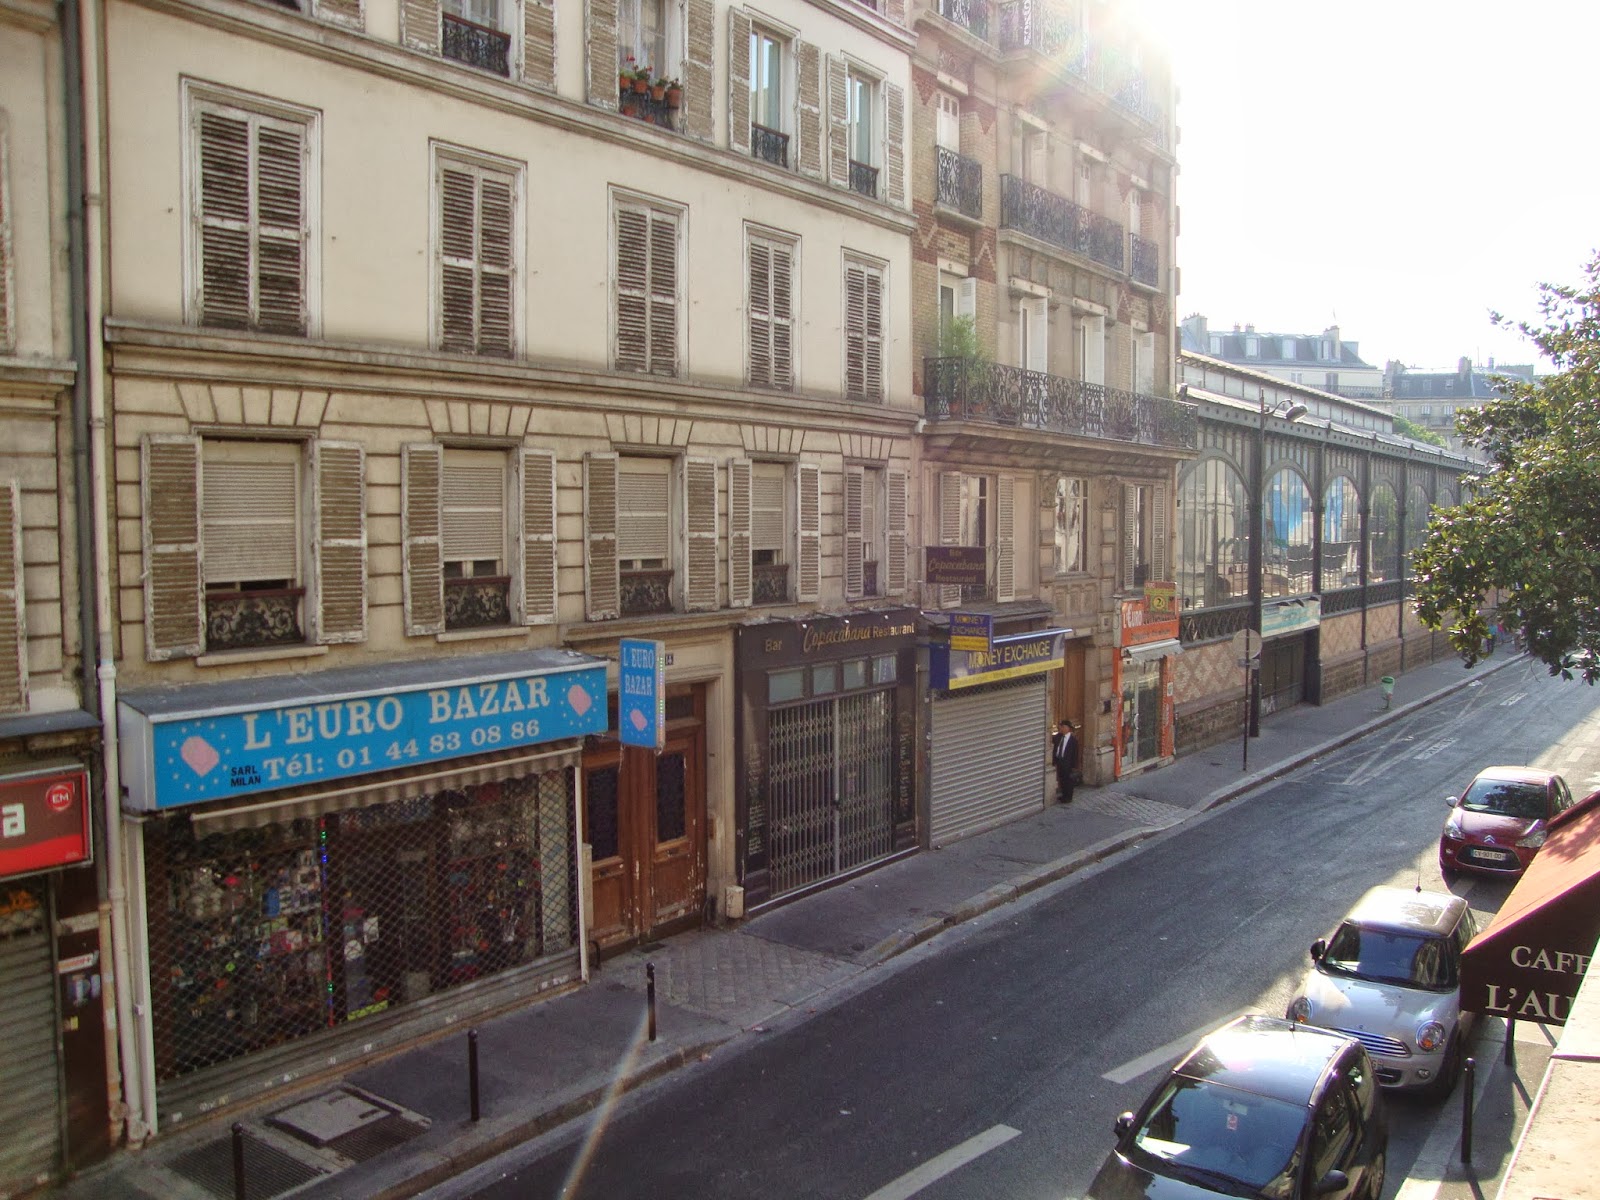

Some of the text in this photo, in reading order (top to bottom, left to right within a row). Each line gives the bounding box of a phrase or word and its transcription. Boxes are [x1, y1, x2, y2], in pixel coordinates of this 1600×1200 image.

[954, 614, 985, 624] MONEY
[803, 622, 915, 653] Copacabana Restaurant
[952, 626, 987, 636] EXCHANGE
[765, 639, 783, 652] Bar
[968, 648, 1003, 670] MONEY
[1004, 640, 1051, 663] EXCHANGE
[624, 674, 652, 696] BAZAR
[242, 677, 549, 750] L'EURO BAZAR
[263, 719, 540, 781] Tél: 01 44 83 08 86
[230, 765, 259, 777] SARL
[230, 775, 261, 788] MILAN
